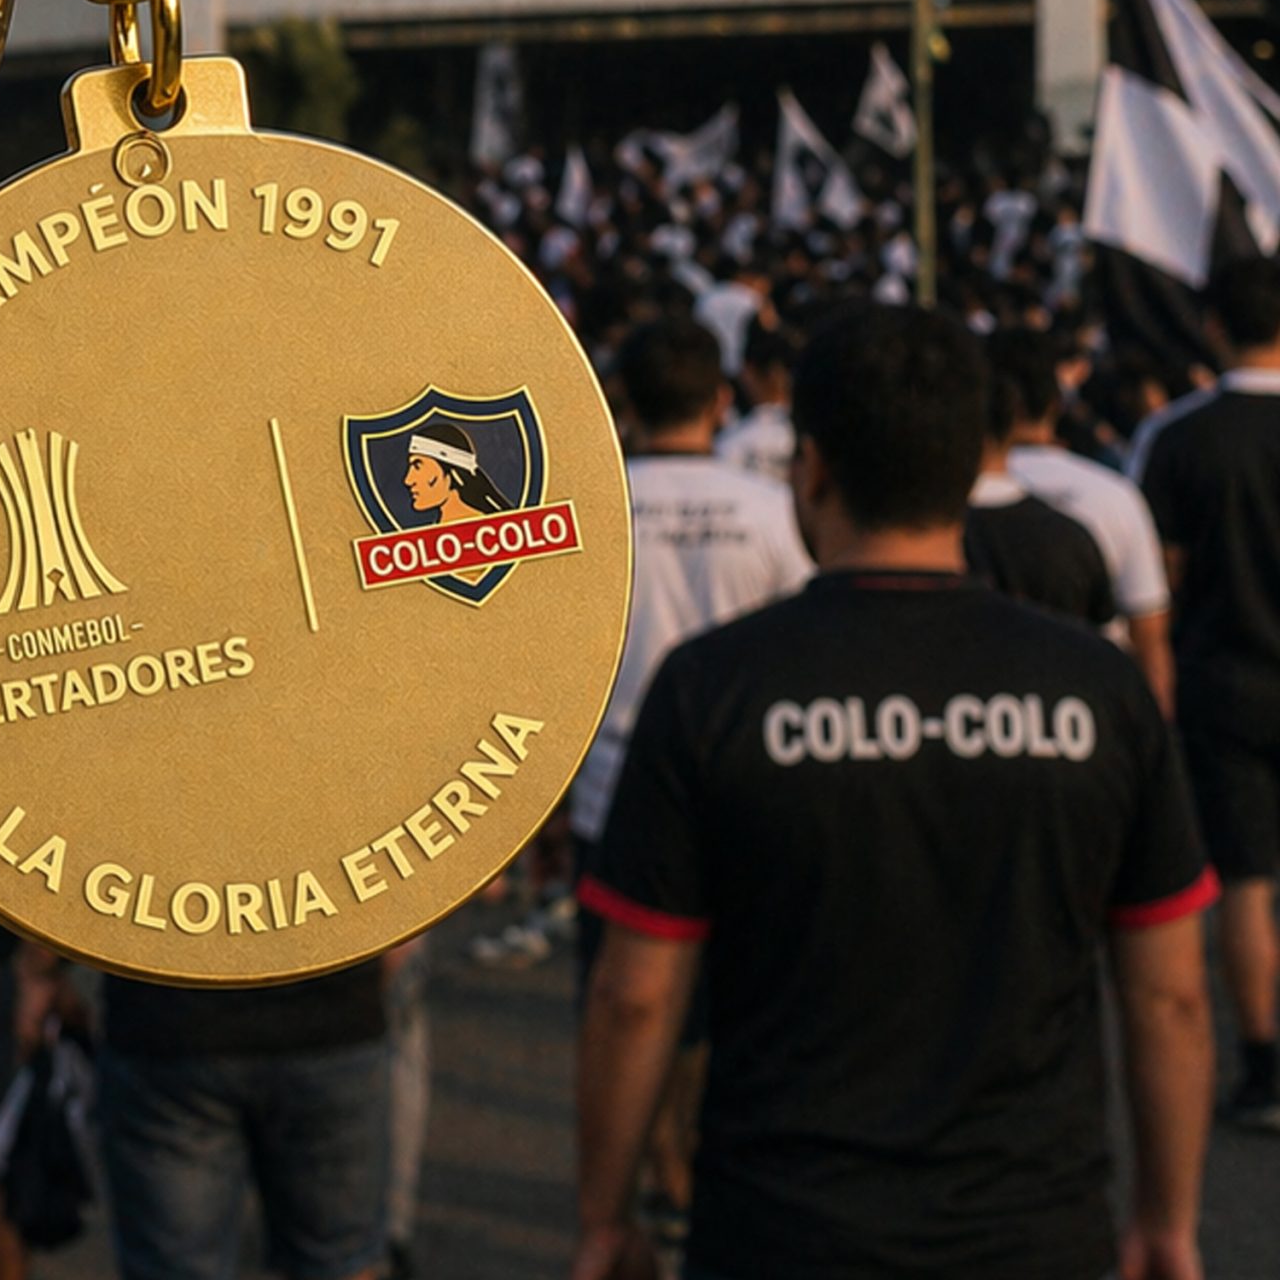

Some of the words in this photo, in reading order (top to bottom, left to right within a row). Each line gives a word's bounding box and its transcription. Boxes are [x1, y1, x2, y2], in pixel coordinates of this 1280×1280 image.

[251, 181, 401, 268] 1991
[368, 512, 568, 577] COLO-COLO
[763, 693, 1097, 766] COLO-COLO
[84, 862, 338, 937] GLORIA
[341, 709, 545, 903] ETERNA
